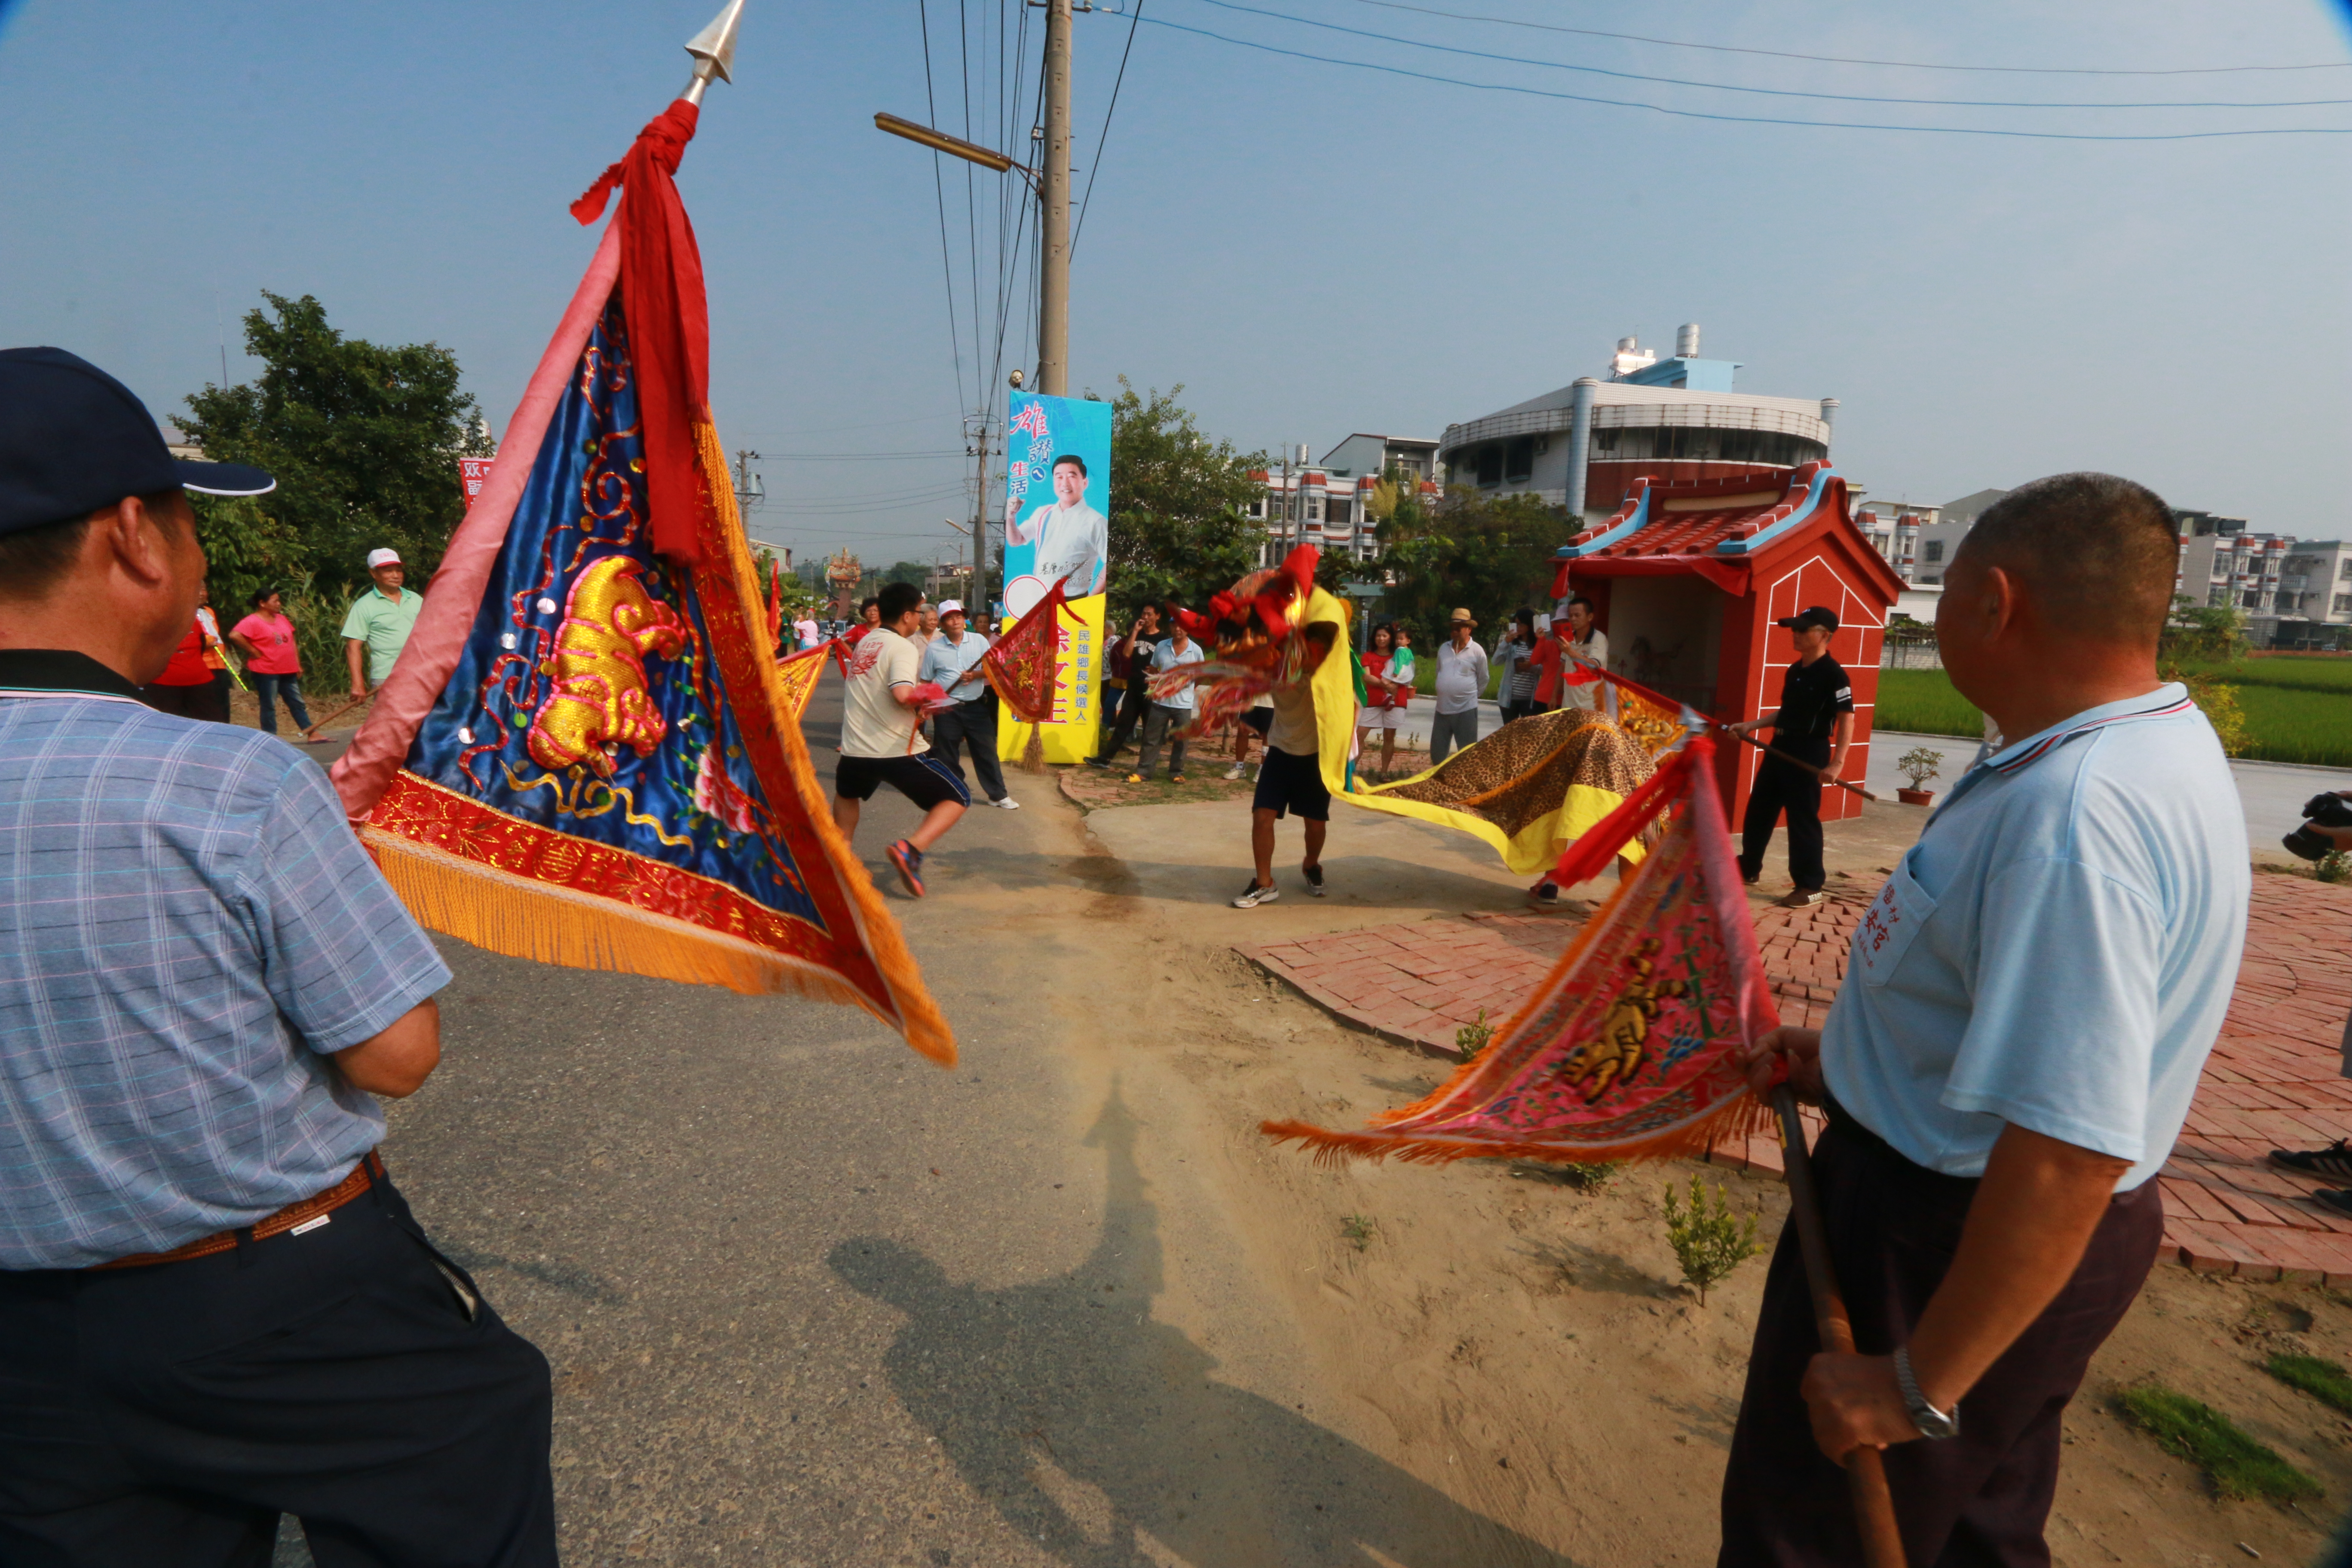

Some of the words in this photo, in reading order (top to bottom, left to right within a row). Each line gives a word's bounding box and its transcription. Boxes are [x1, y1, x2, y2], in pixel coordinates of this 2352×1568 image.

[1011, 462, 1028, 494] 生活
[1074, 630, 1090, 722] 民雄鄉長候選人
